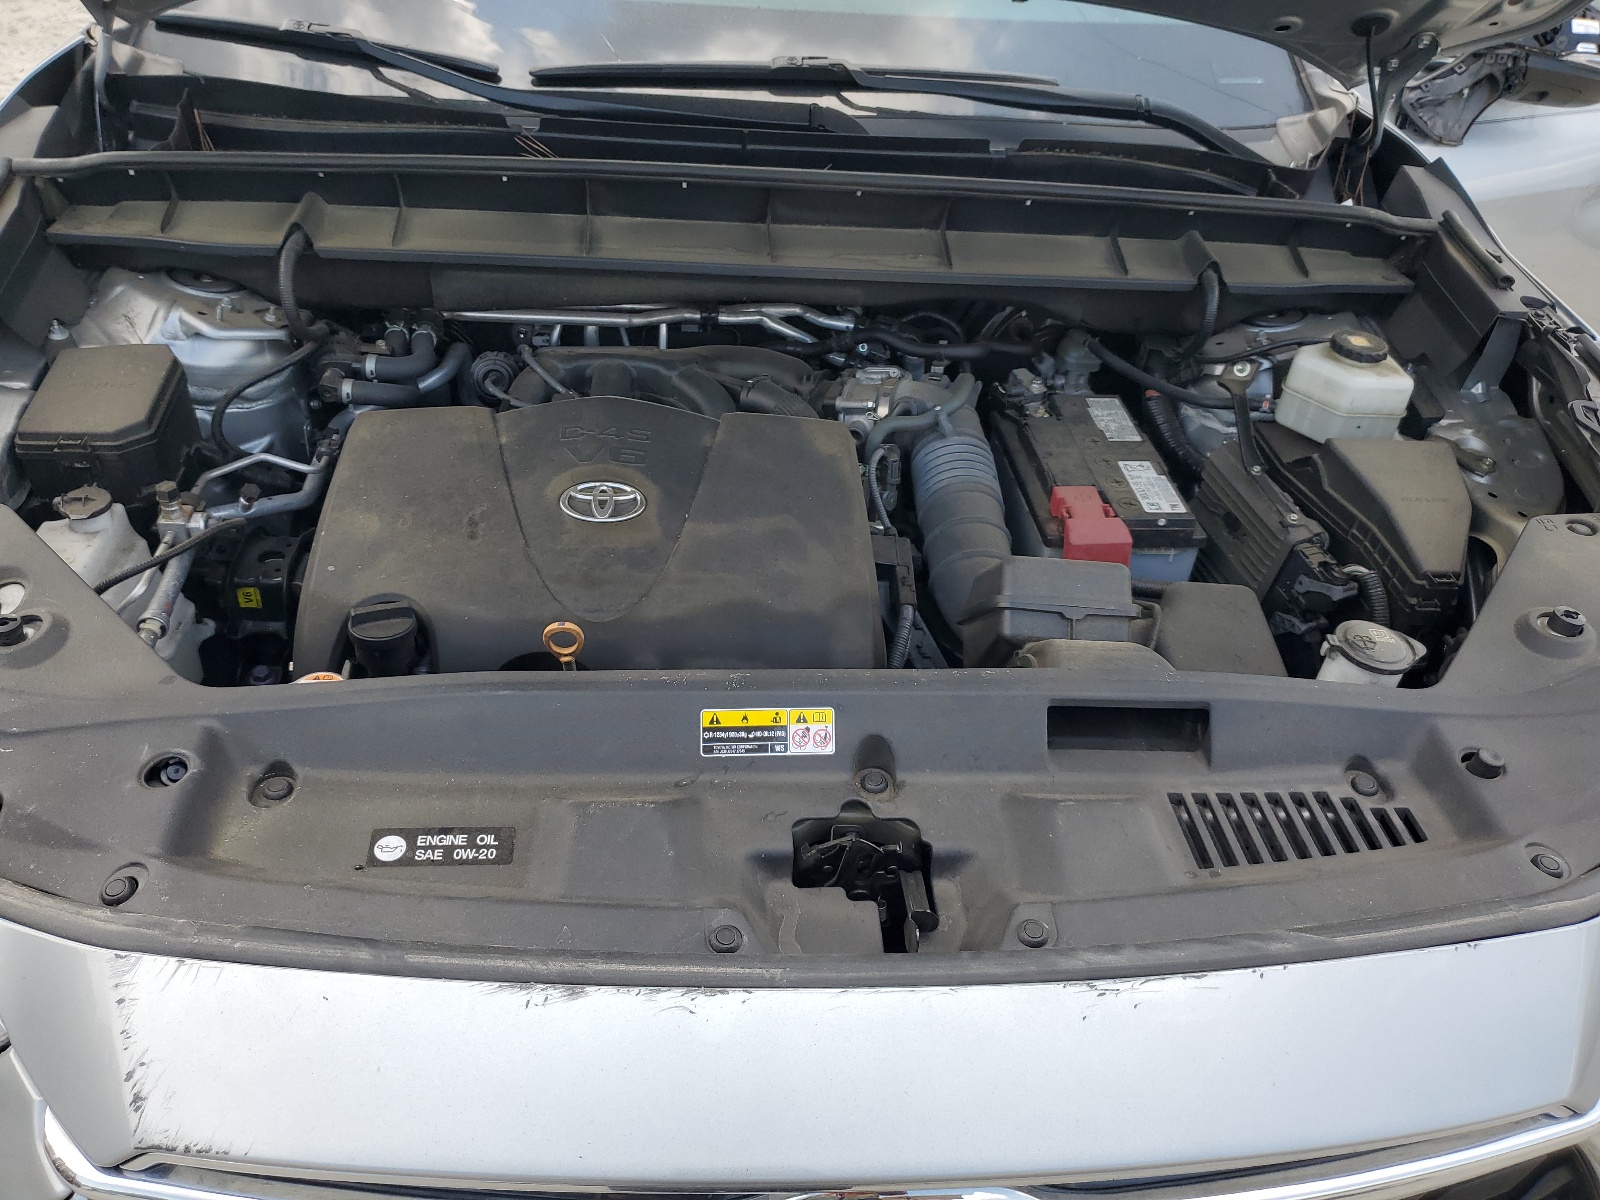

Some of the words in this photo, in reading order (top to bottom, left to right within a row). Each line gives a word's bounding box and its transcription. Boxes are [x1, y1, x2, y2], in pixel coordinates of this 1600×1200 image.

[563, 445, 647, 467] V6
[242, 591, 254, 604] V6
[774, 744, 785, 752] WS
[416, 834, 468, 846] ENGINE
[476, 834, 499, 845] OIL
[415, 849, 443, 861] SAE
[453, 848, 497, 860] 0W-20
